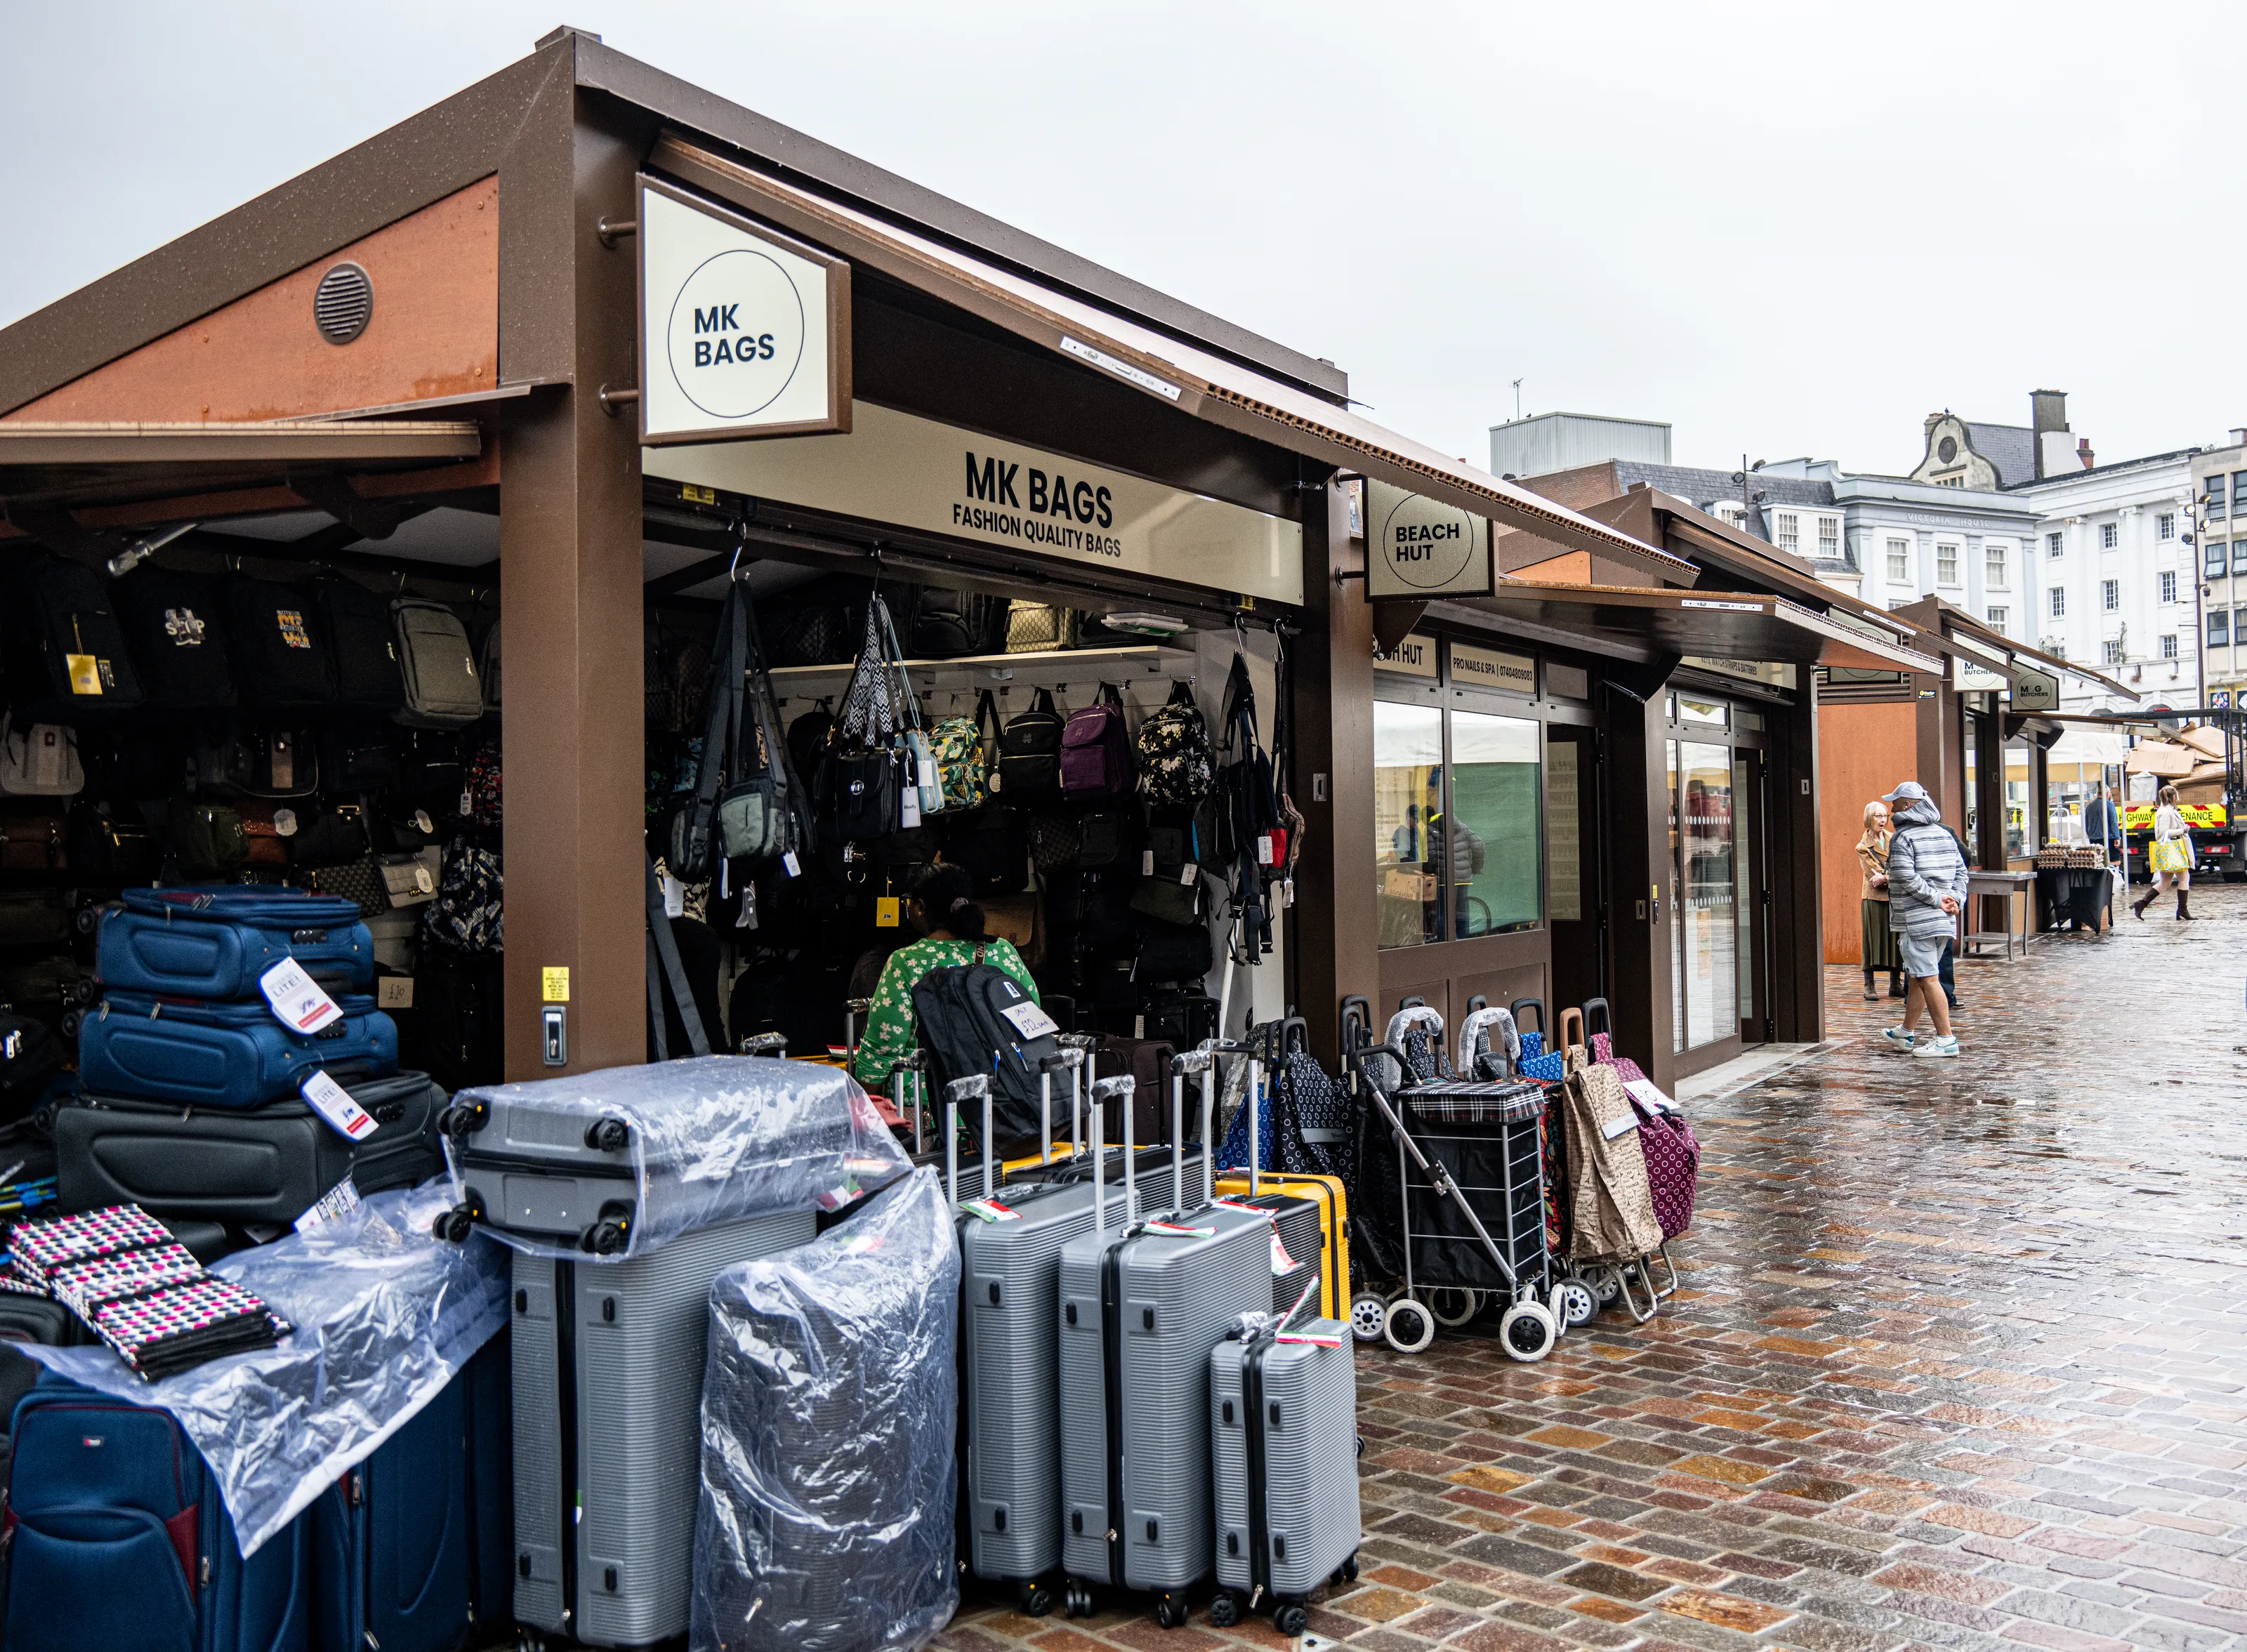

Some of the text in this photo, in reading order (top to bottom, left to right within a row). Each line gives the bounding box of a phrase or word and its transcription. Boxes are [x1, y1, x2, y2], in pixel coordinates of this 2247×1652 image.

[694, 303, 739, 334] MK
[695, 333, 775, 367] BAGS
[966, 451, 1112, 529] MK BAGS
[953, 503, 1121, 557] FASHION QUALITY BAGS
[1396, 523, 1459, 542] BEACH
[1397, 545, 1433, 562] HUT
[1402, 643, 1423, 665] HUT
[1725, 660, 1737, 670] STRAPS
[1453, 657, 1464, 669] PRO
[1465, 659, 1480, 672] NAILS
[1480, 662, 1484, 673] &
[1485, 663, 1495, 675] SPA
[1500, 666, 1532, 681] 07404809083
[2119, 813, 2153, 822] HGHWAY
[272, 975, 301, 997] LITE!
[1626, 1182, 1640, 1190] FRANCE
